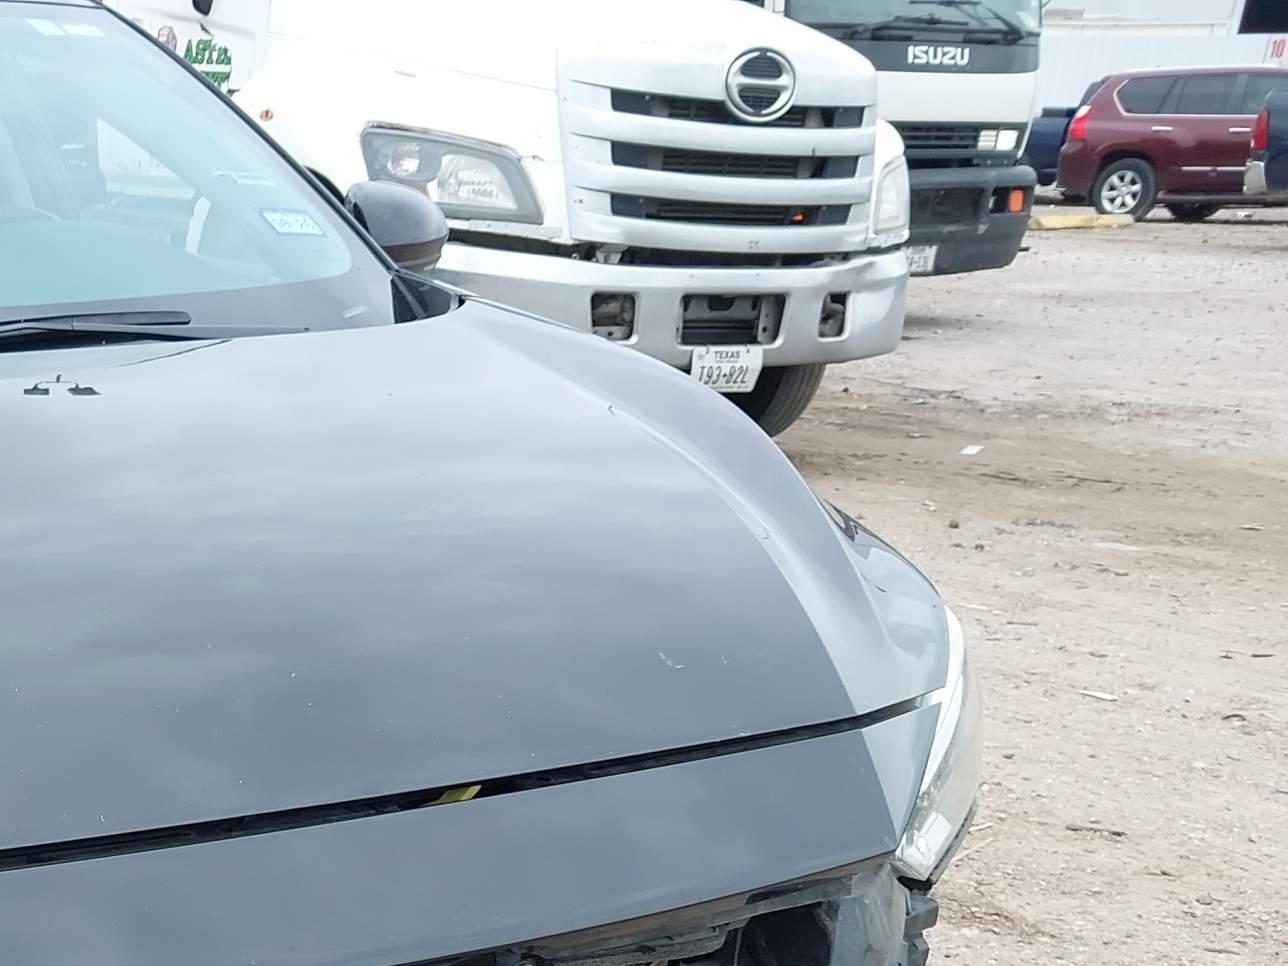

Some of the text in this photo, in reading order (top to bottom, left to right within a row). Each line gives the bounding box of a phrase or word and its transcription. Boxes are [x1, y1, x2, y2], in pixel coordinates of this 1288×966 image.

[907, 45, 970, 65] ISUZU
[1270, 38, 1286, 58] 10
[714, 351, 741, 360] TEXAS
